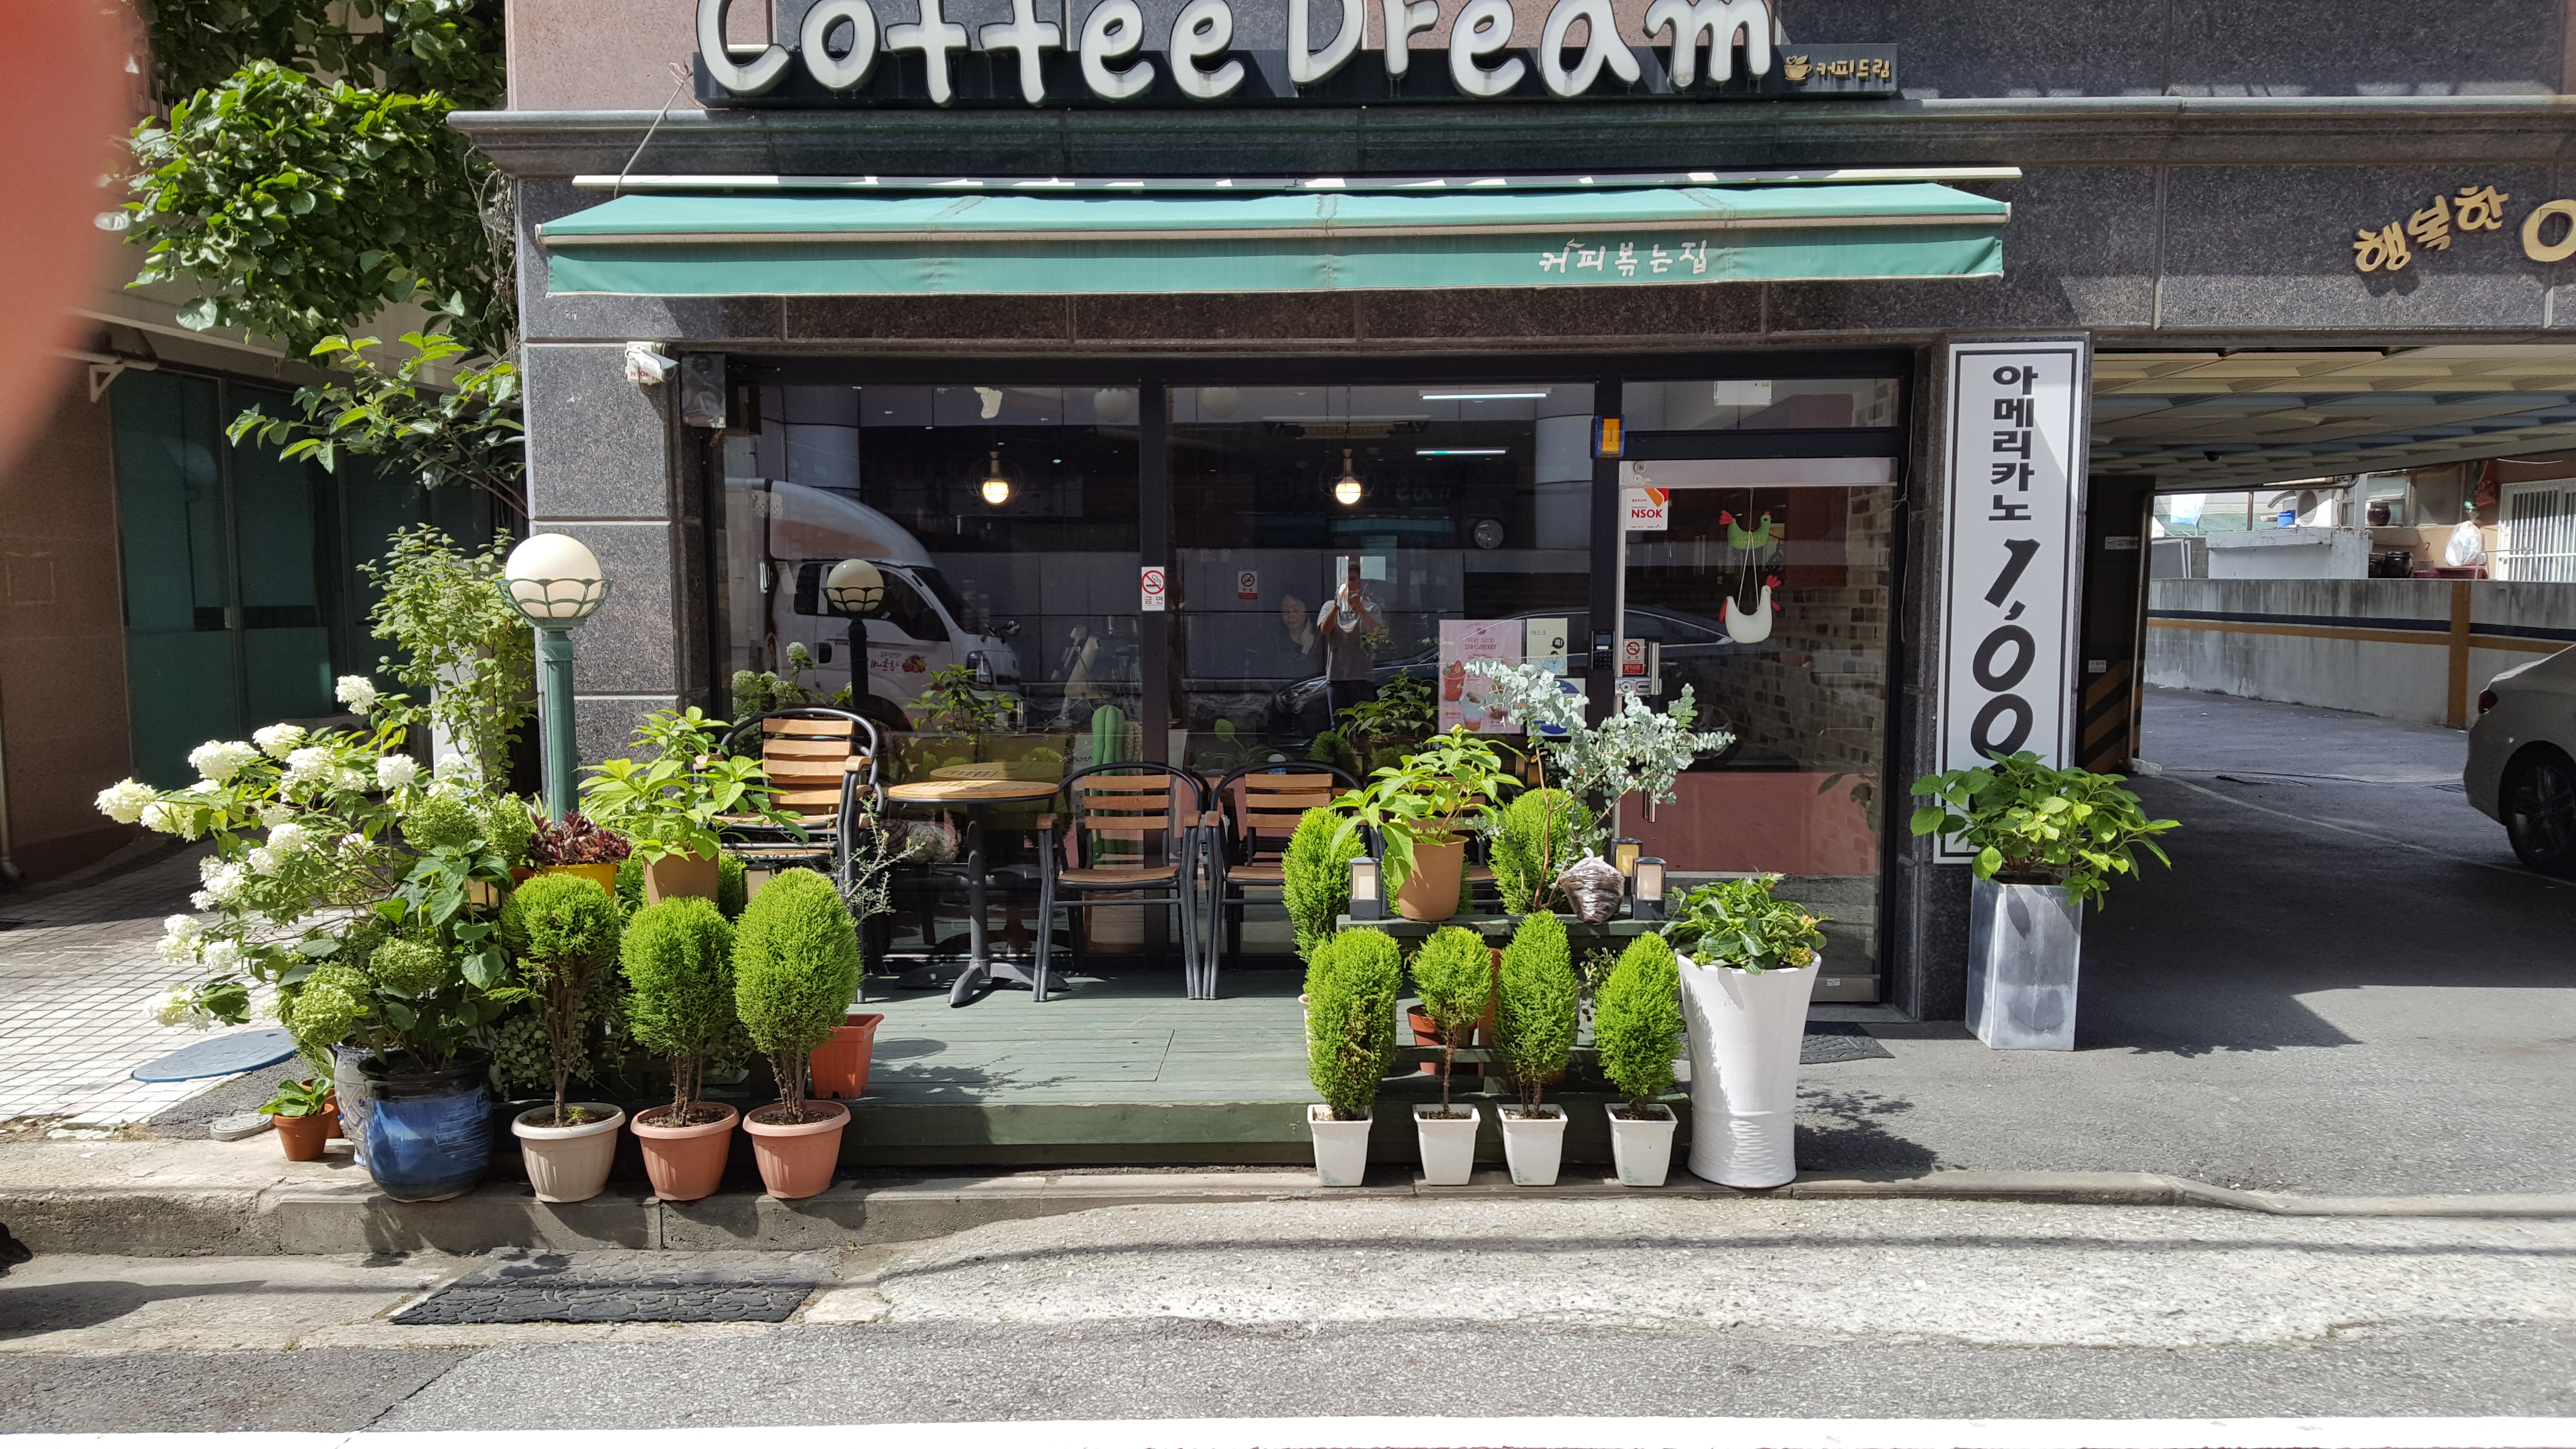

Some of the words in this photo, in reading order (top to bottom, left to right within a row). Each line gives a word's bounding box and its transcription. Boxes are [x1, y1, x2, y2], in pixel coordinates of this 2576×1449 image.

[696, 0, 1247, 108] Coffee
[1288, 0, 1772, 98] Dream
[1816, 58, 1890, 79] 커피드림
[2353, 184, 2509, 273] 행복한
[1988, 365, 2039, 522] 아메리카노
[1631, 509, 1663, 518] NSOK
[1970, 538, 2041, 771] 1,00
